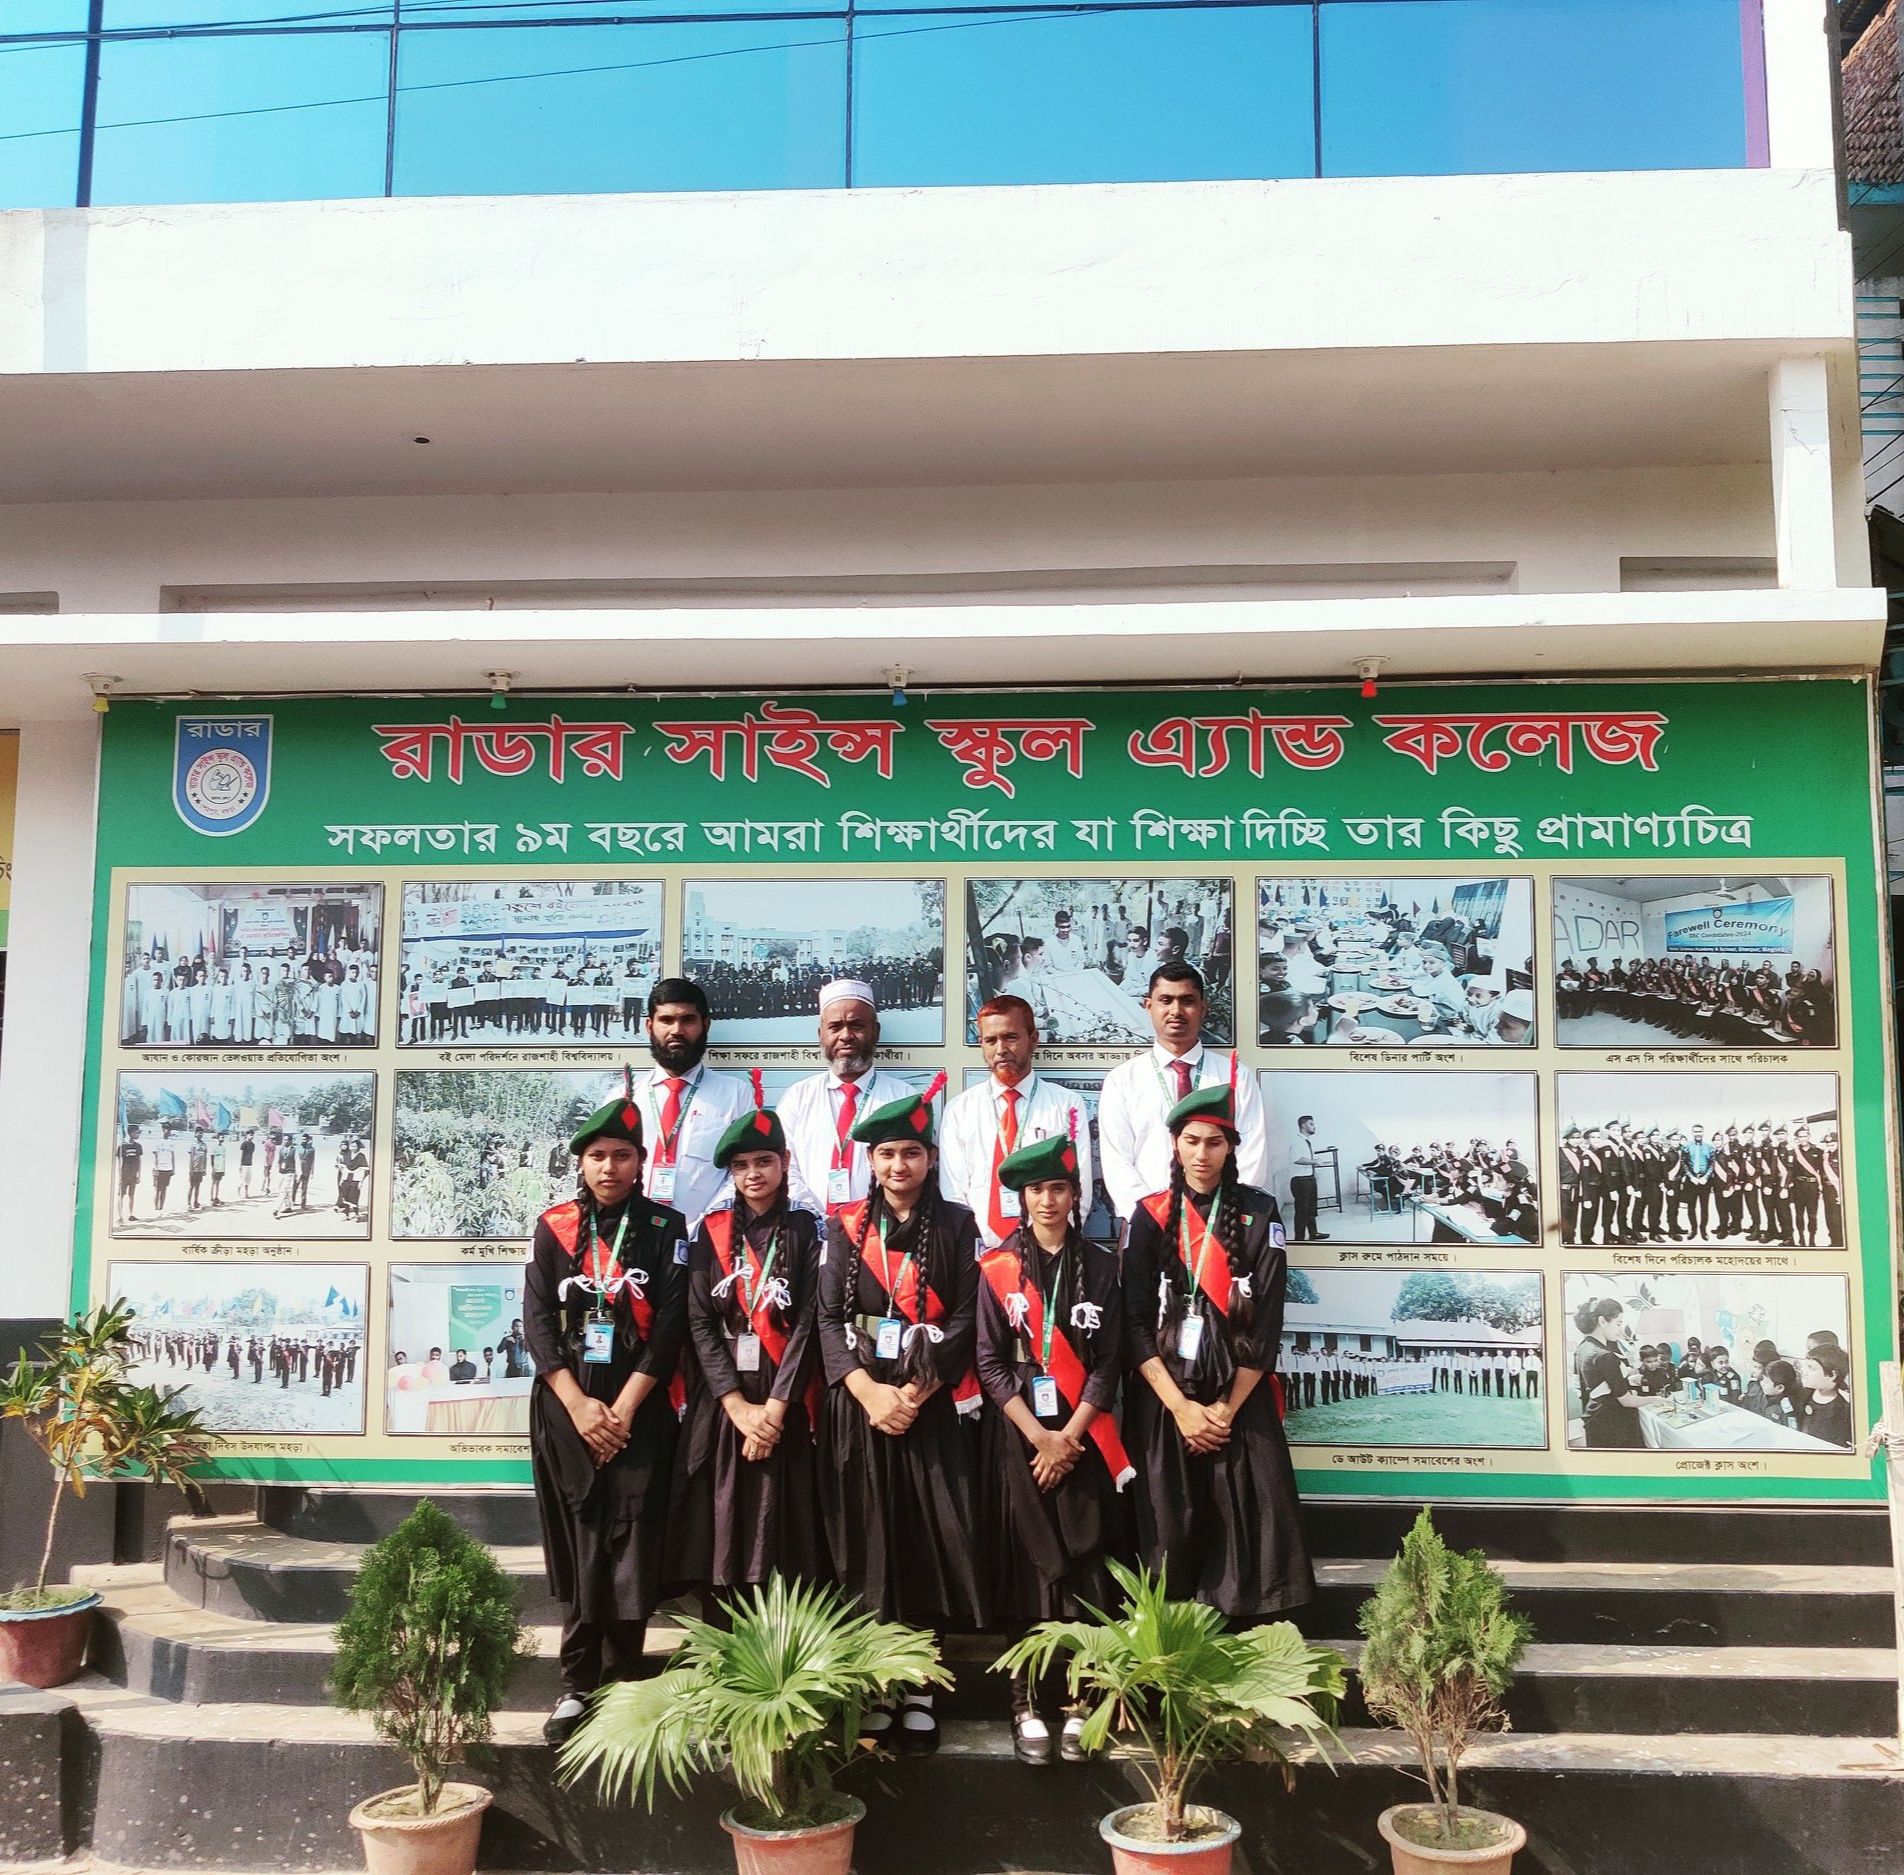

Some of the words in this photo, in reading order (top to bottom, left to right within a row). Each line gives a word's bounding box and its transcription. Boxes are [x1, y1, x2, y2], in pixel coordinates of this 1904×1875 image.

[184, 721, 264, 739] রাডার
[371, 714, 635, 785] রাডার
[652, 699, 906, 788] সাইন্স
[923, 717, 1097, 799] স্কুল
[1127, 706, 1354, 779] এ্যান্ড
[1371, 711, 1670, 775] কলেজ
[324, 820, 500, 855] সফলতার
[515, 823, 571, 854] ৯ম
[584, 822, 688, 857] বছরে
[701, 817, 821, 855] আমরা
[836, 810, 1059, 853] শিক্ষার্থীদের
[1071, 816, 1116, 852] যা
[1129, 808, 1234, 851] শিক্ষা
[1239, 808, 1328, 852] দিচ্ছি
[1341, 814, 1426, 850] তার
[1437, 806, 1524, 858] কিছু
[1537, 804, 1754, 849] প্রামাণ্যচিত্র
[1667, 921, 1711, 939] Farewell
[1713, 919, 1789, 937] Ceremony
[321, 1053, 340, 1062] অংশ
[438, 1052, 452, 1062] বই
[455, 1052, 476, 1062] মেলা
[480, 1051, 519, 1062] পরিদর্শনে
[522, 1050, 558, 1062] রাজশাহী
[561, 1050, 613, 1062] বিশ্ববিদ্যালয়
[708, 1049, 730, 1061] শিক্ষা
[734, 1051, 759, 1061] সফরে
[762, 1049, 798, 1061] রাজশাহী
[1043, 1050, 1063, 1061] দিনে
[1067, 1052, 1093, 1061] অবসর
[1350, 1051, 1377, 1062] বিশেষ
[1381, 1051, 1408, 1062] ডিনার
[1411, 1051, 1432, 1062] পার্টি
[1435, 1053, 1455, 1062] অংশ
[1606, 1055, 1621, 1063] এস
[1625, 1055, 1640, 1063] এস
[1643, 1052, 1654, 1063] সি
[1720, 1055, 1742, 1063] সাথে
[1746, 1053, 1788, 1063] পরিচালক
[1339, 1251, 1358, 1261] ক্লাস
[1386, 1250, 1421, 1262] পাঠদান
[1612, 1252, 1641, 1264] বিশেষ
[1645, 1253, 1666, 1265] দিনে
[1670, 1253, 1712, 1265] পরিচালক
[1765, 1256, 1789, 1266] সাথে
[280, 1442, 303, 1452] মহড়া
[1332, 1454, 1344, 1463] ডে
[1347, 1453, 1374, 1464] আউট
[1413, 1456, 1460, 1466] সমাবেশের
[1464, 1457, 1485, 1466] অংশ
[1714, 1460, 1734, 1471] ক্লাস
[1737, 1460, 1759, 1470] অংশ
